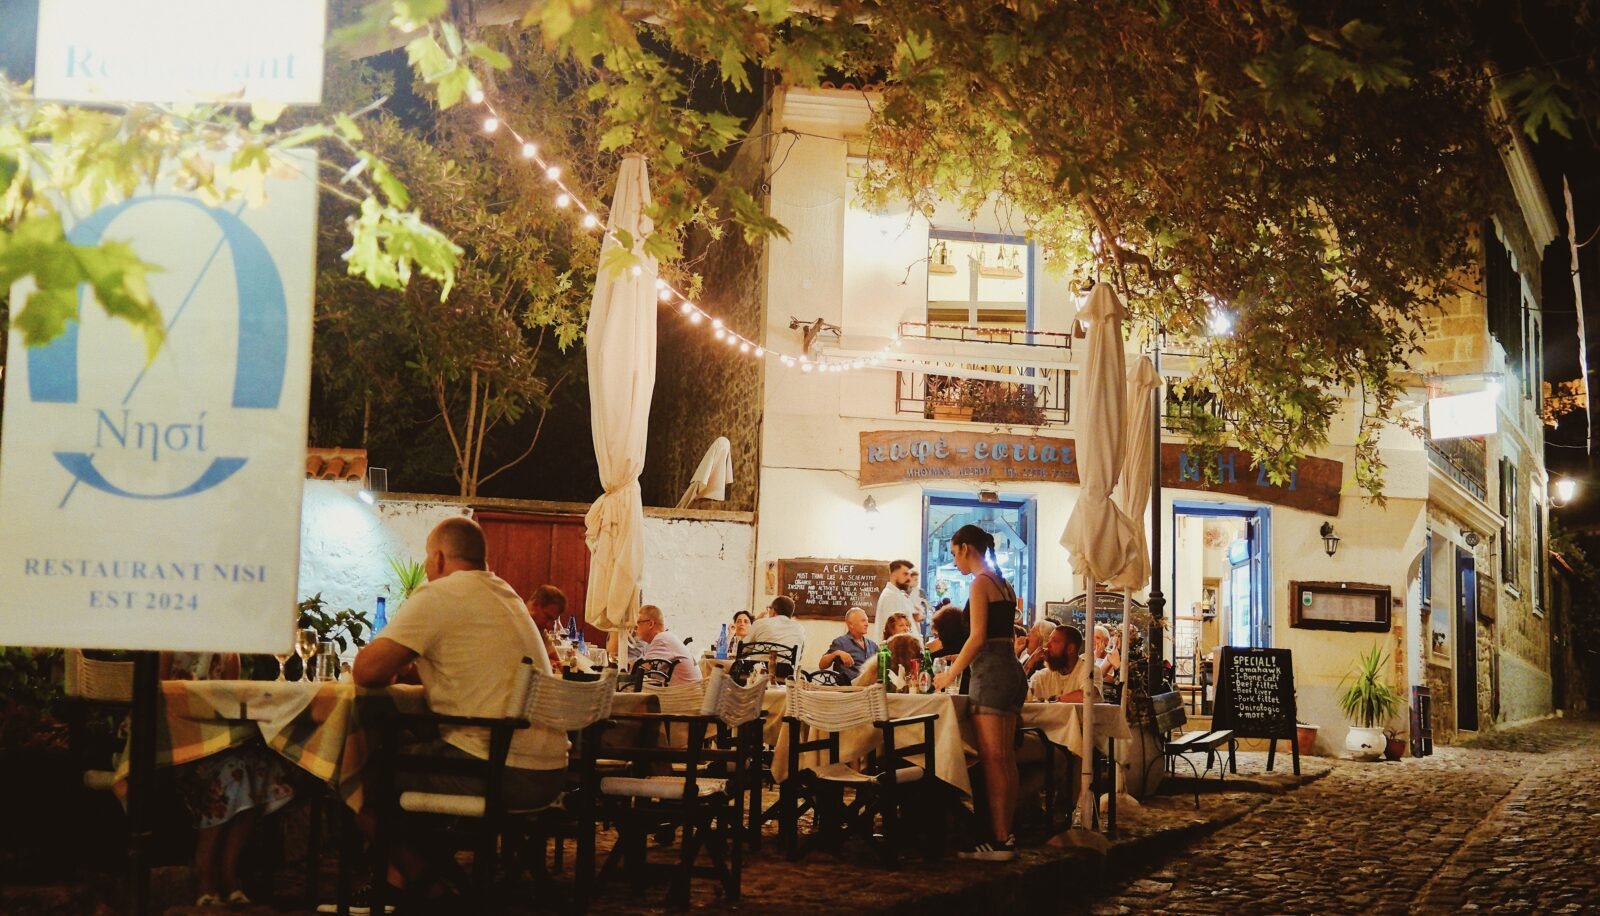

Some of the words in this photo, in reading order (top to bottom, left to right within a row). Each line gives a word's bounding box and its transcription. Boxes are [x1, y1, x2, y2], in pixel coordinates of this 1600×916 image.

[65, 45, 296, 80] Reant
[94, 408, 208, 462] Νησί
[24, 558, 205, 581] RESTAURANT
[213, 563, 267, 584] NISI
[823, 564, 830, 573] A
[833, 564, 855, 573] CHEF
[88, 590, 139, 609] EST
[145, 593, 200, 611] 2024
